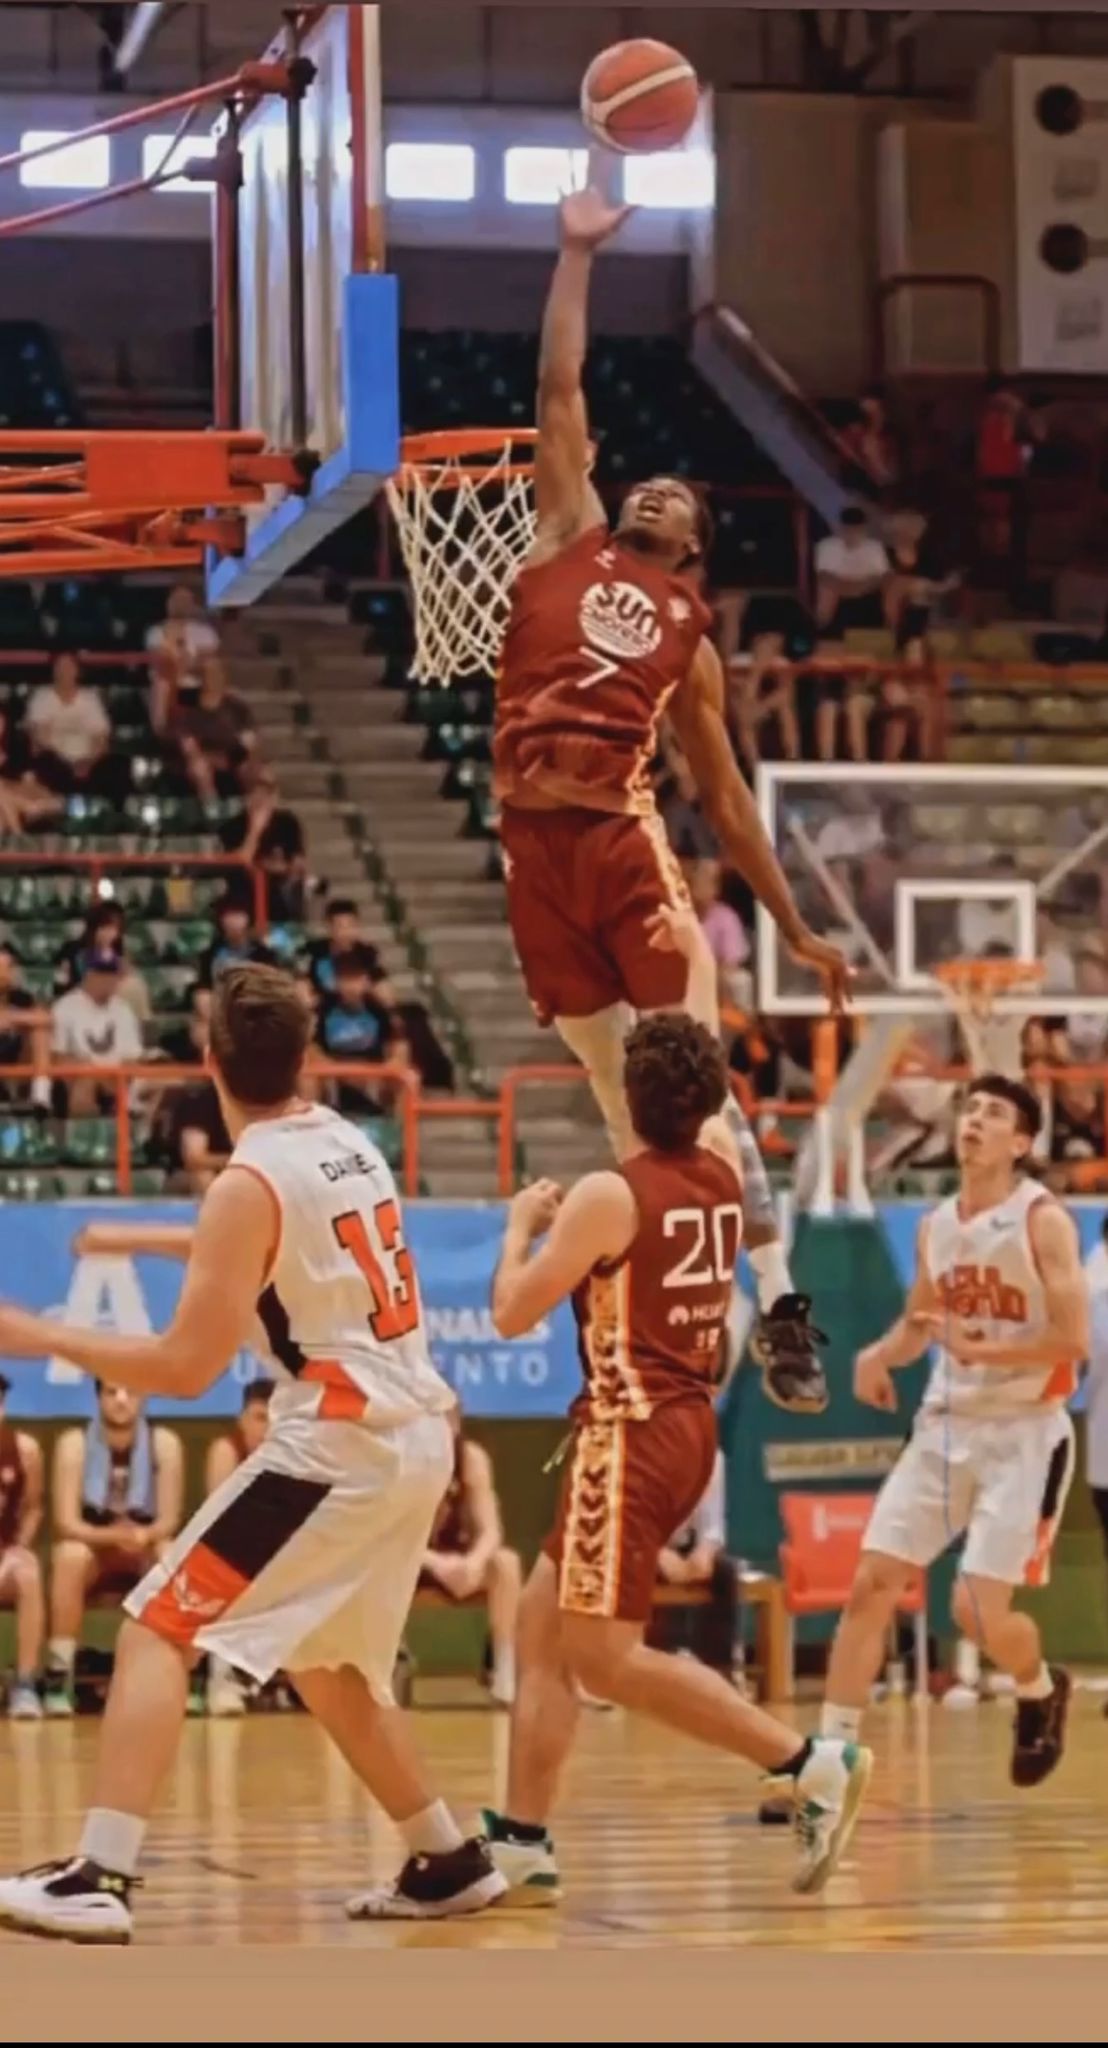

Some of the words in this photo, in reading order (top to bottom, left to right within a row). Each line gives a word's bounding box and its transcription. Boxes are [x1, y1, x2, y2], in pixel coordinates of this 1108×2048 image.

[577, 647, 619, 689] 7
[318, 1152, 378, 1183] DAEL
[331, 1198, 420, 1344] 13
[662, 1203, 743, 1288] 20
